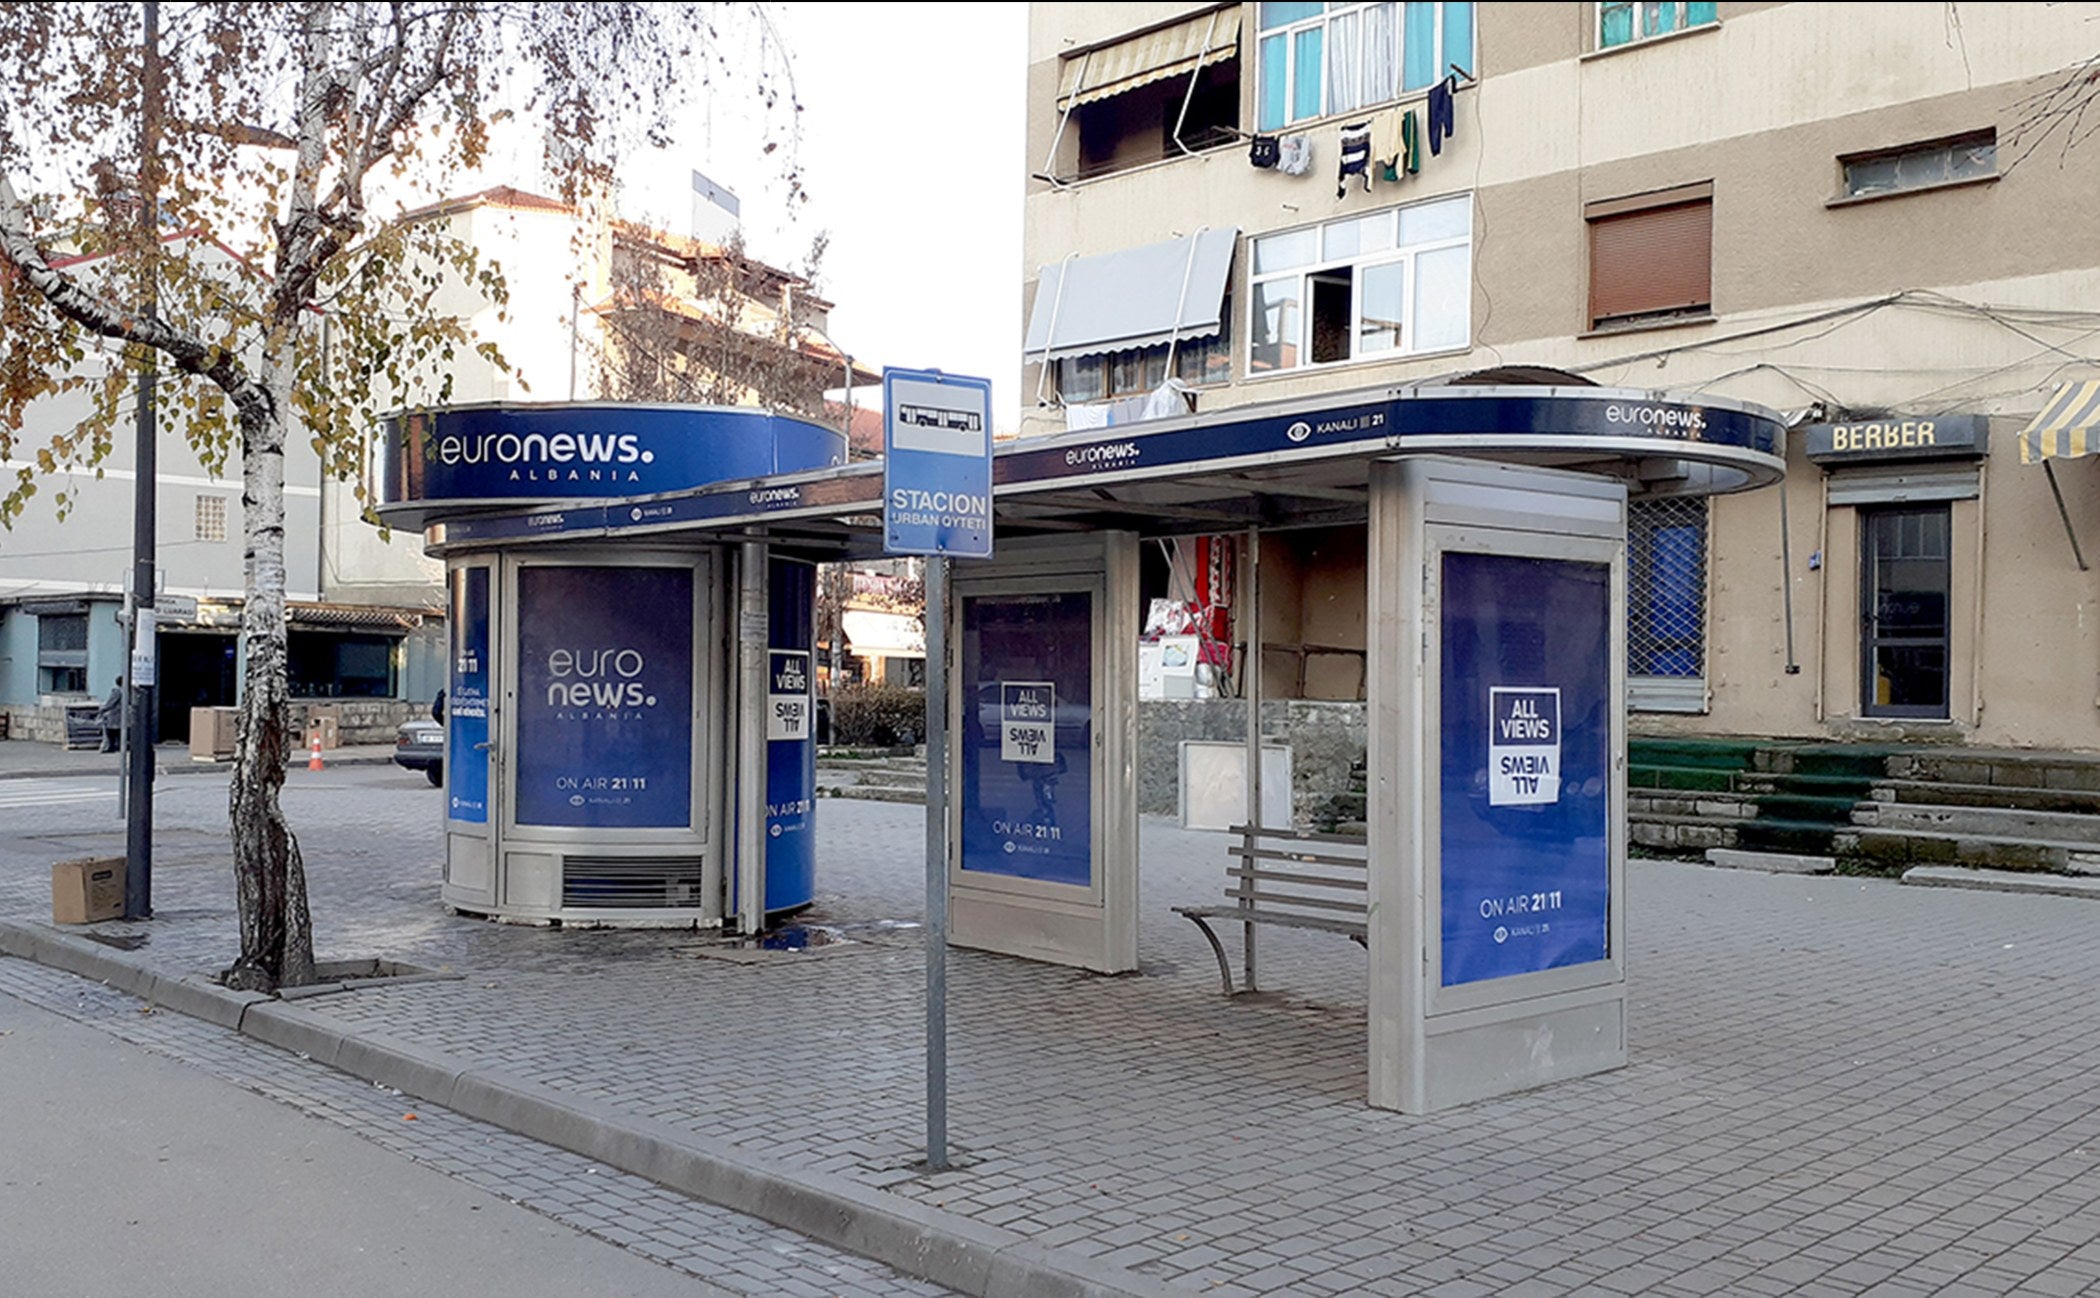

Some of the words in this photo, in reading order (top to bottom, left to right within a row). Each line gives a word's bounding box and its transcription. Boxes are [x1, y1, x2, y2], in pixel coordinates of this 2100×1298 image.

[1371, 413, 1384, 426] 21
[1605, 405, 1707, 429] euronews.
[1833, 422, 1936, 451] BERBER
[440, 433, 654, 465] euronews.
[1065, 442, 1140, 465] euronews.
[509, 469, 640, 482] ALBANIA
[892, 488, 986, 515] STACION
[892, 512, 940, 526] URBAN
[548, 649, 643, 677] euro
[784, 659, 801, 674] ALL
[776, 674, 806, 690] VIEWS
[547, 682, 657, 707] news.
[1018, 690, 1038, 704] ALL
[556, 712, 642, 720] ALBANIA
[776, 702, 805, 718] VIEWS
[1009, 703, 1047, 718] VIEWS
[1511, 699, 1539, 719] ALL
[783, 718, 800, 732] ALL
[1501, 719, 1550, 739] VIEWS
[1009, 727, 1047, 743] VIEWS
[1018, 741, 1039, 756] ALL
[1501, 755, 1550, 775] VIEWS
[556, 777, 579, 790] ON
[582, 777, 608, 790] AIR
[1511, 776, 1539, 795] ALL
[992, 820, 1011, 835] ON
[1013, 823, 1033, 837] AIR
[1480, 898, 1504, 919] ON
[1505, 895, 1529, 915] AIR
[1531, 892, 1545, 912] 21
